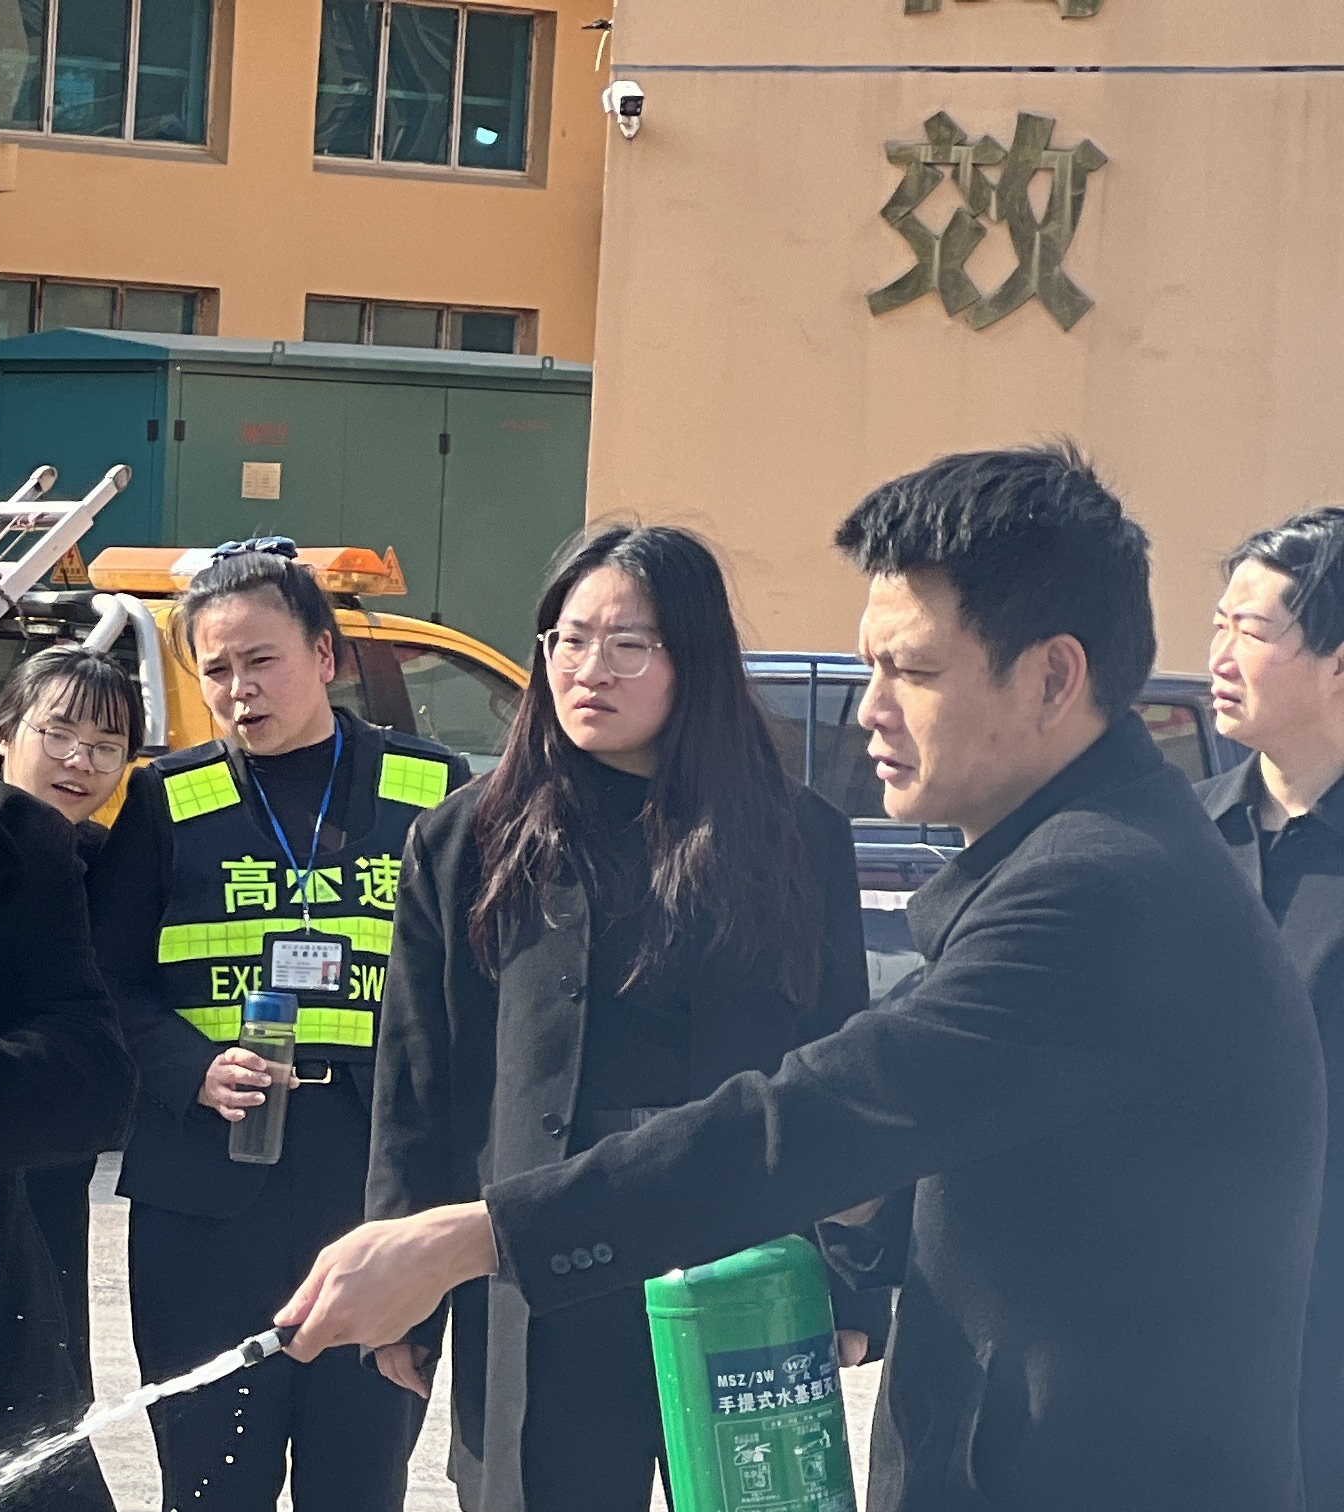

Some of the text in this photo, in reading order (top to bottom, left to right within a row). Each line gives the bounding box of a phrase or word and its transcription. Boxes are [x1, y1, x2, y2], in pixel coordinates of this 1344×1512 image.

[866, 110, 1109, 333] 效
[221, 855, 277, 913] 高
[717, 1369, 775, 1388] MSZ/3W
